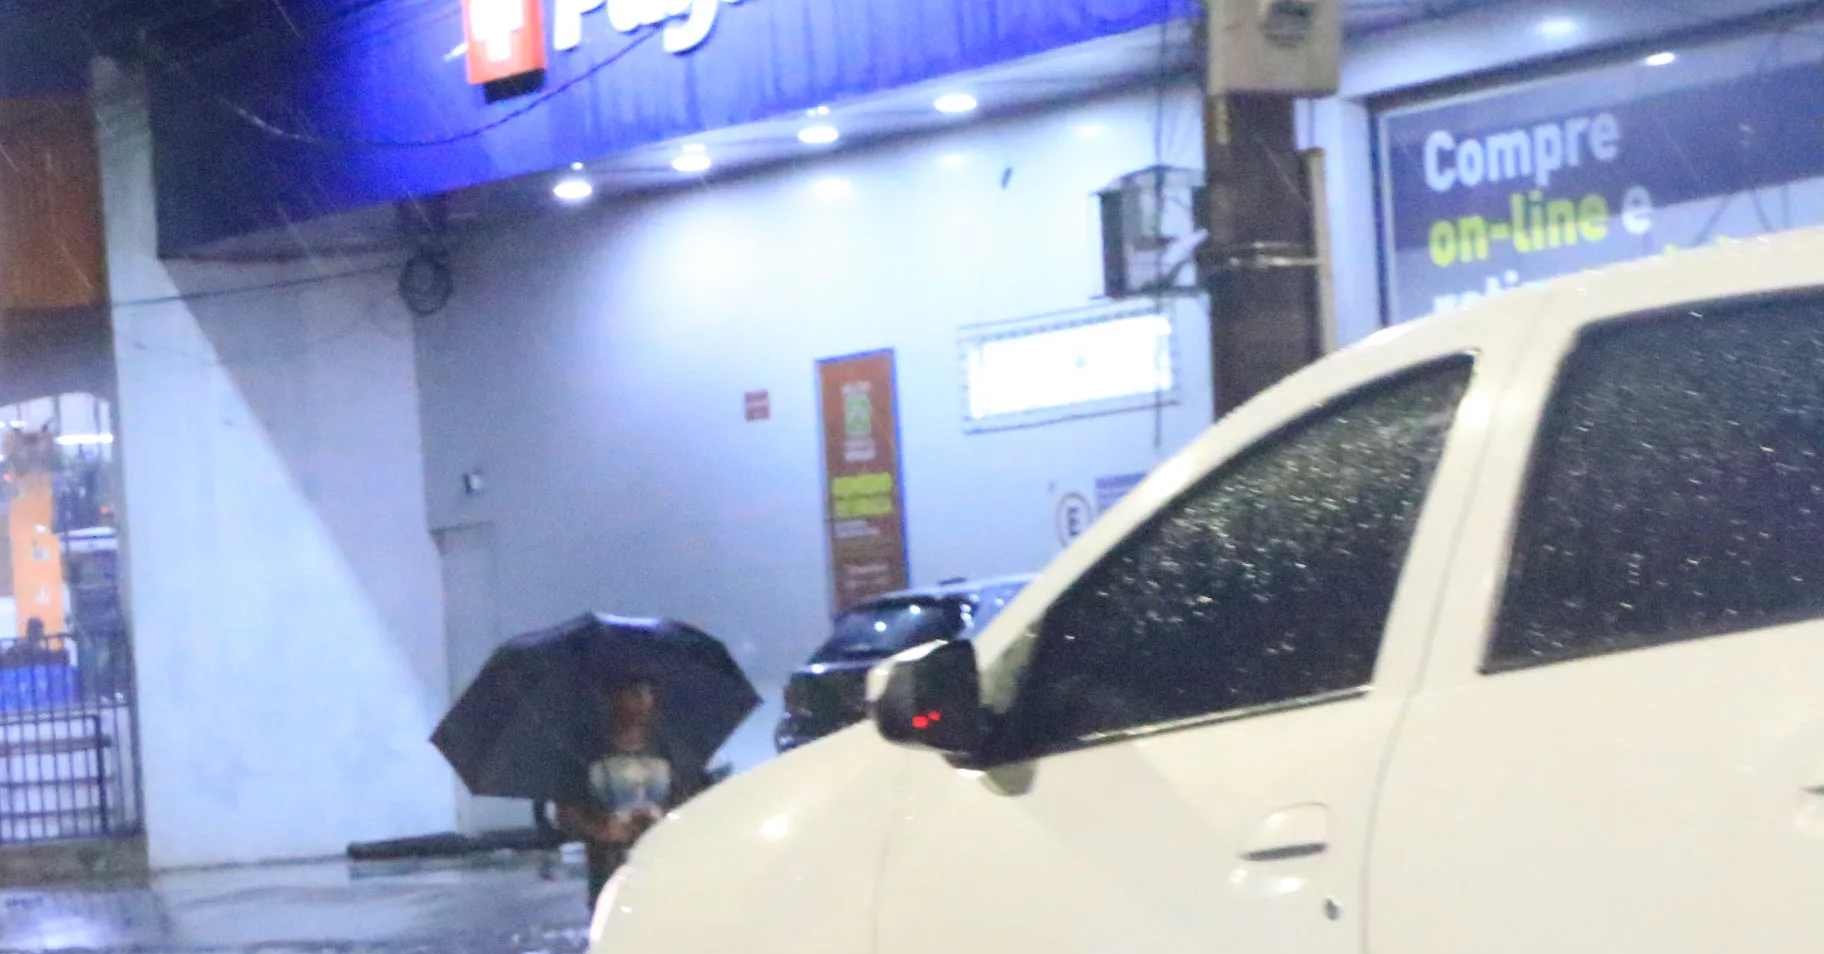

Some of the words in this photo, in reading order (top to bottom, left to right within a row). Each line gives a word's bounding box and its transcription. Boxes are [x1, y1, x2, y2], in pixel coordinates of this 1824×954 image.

[1424, 113, 1620, 192] Compre
[1430, 190, 1609, 267] on-line
[1621, 186, 1653, 234] e
